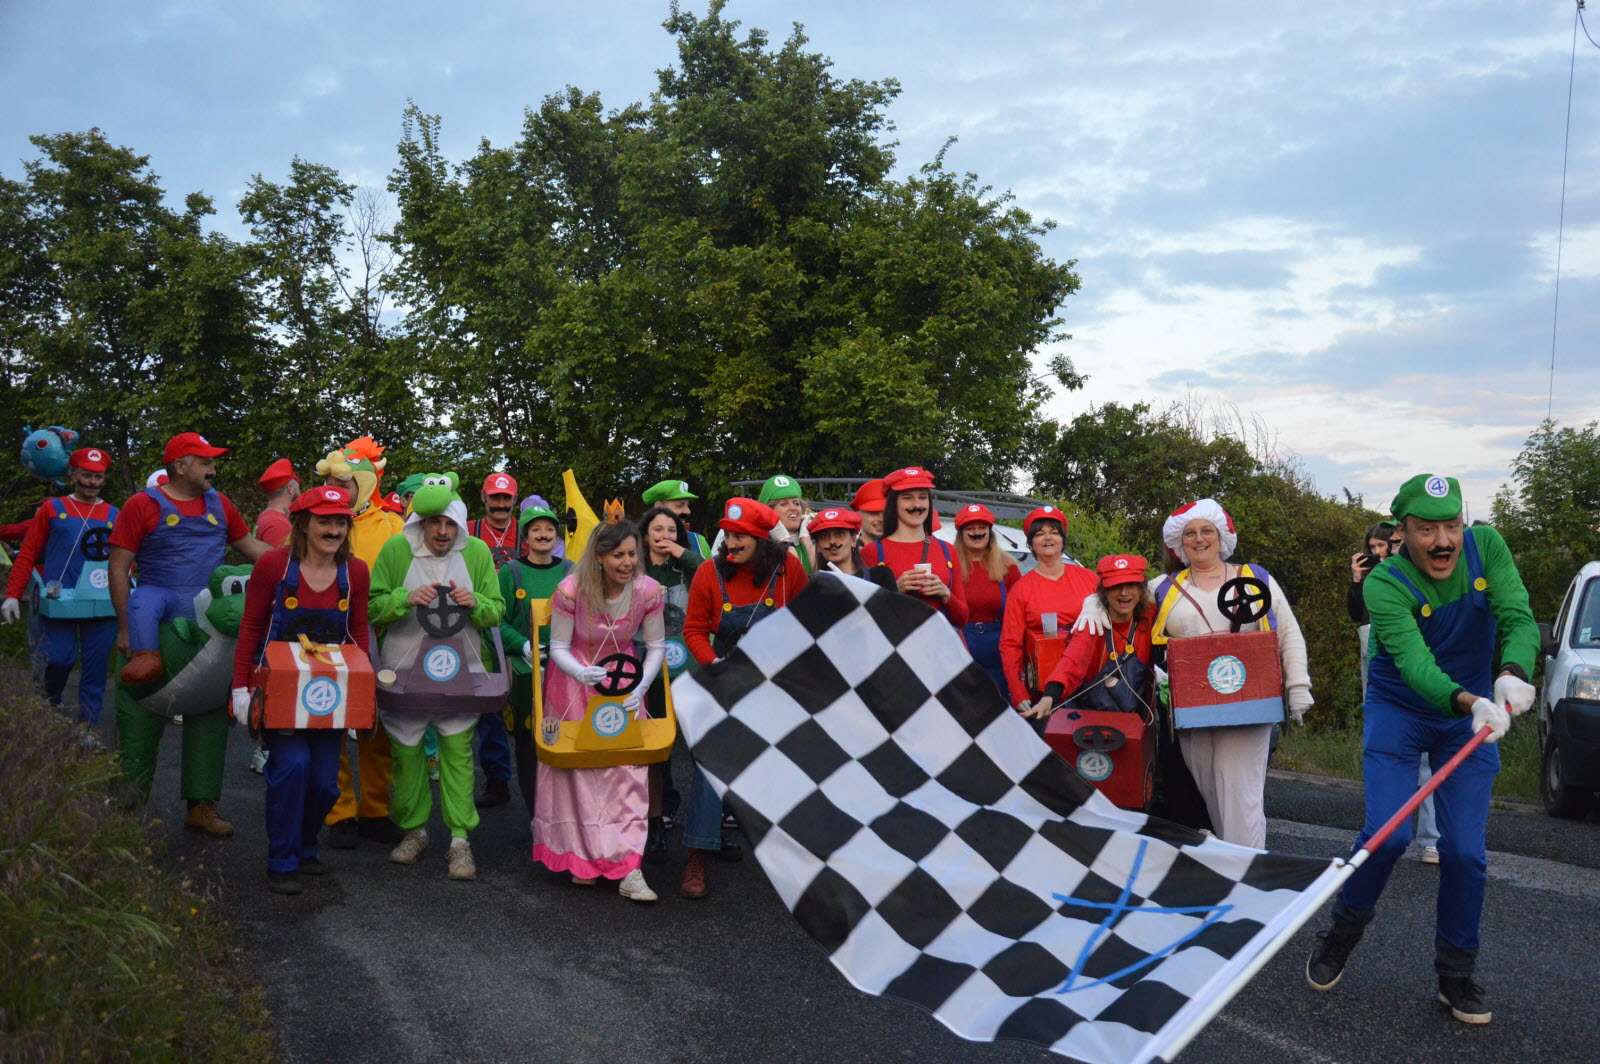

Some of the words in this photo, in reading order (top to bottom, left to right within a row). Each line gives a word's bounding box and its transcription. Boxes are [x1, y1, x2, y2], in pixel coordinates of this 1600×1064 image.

[496, 478, 509, 486] M
[1431, 479, 1444, 493] 4
[428, 650, 453, 676] 4
[1213, 660, 1238, 687] 4
[307, 681, 333, 709] 4
[598, 705, 621, 731] 4
[1081, 751, 1106, 775] 4
